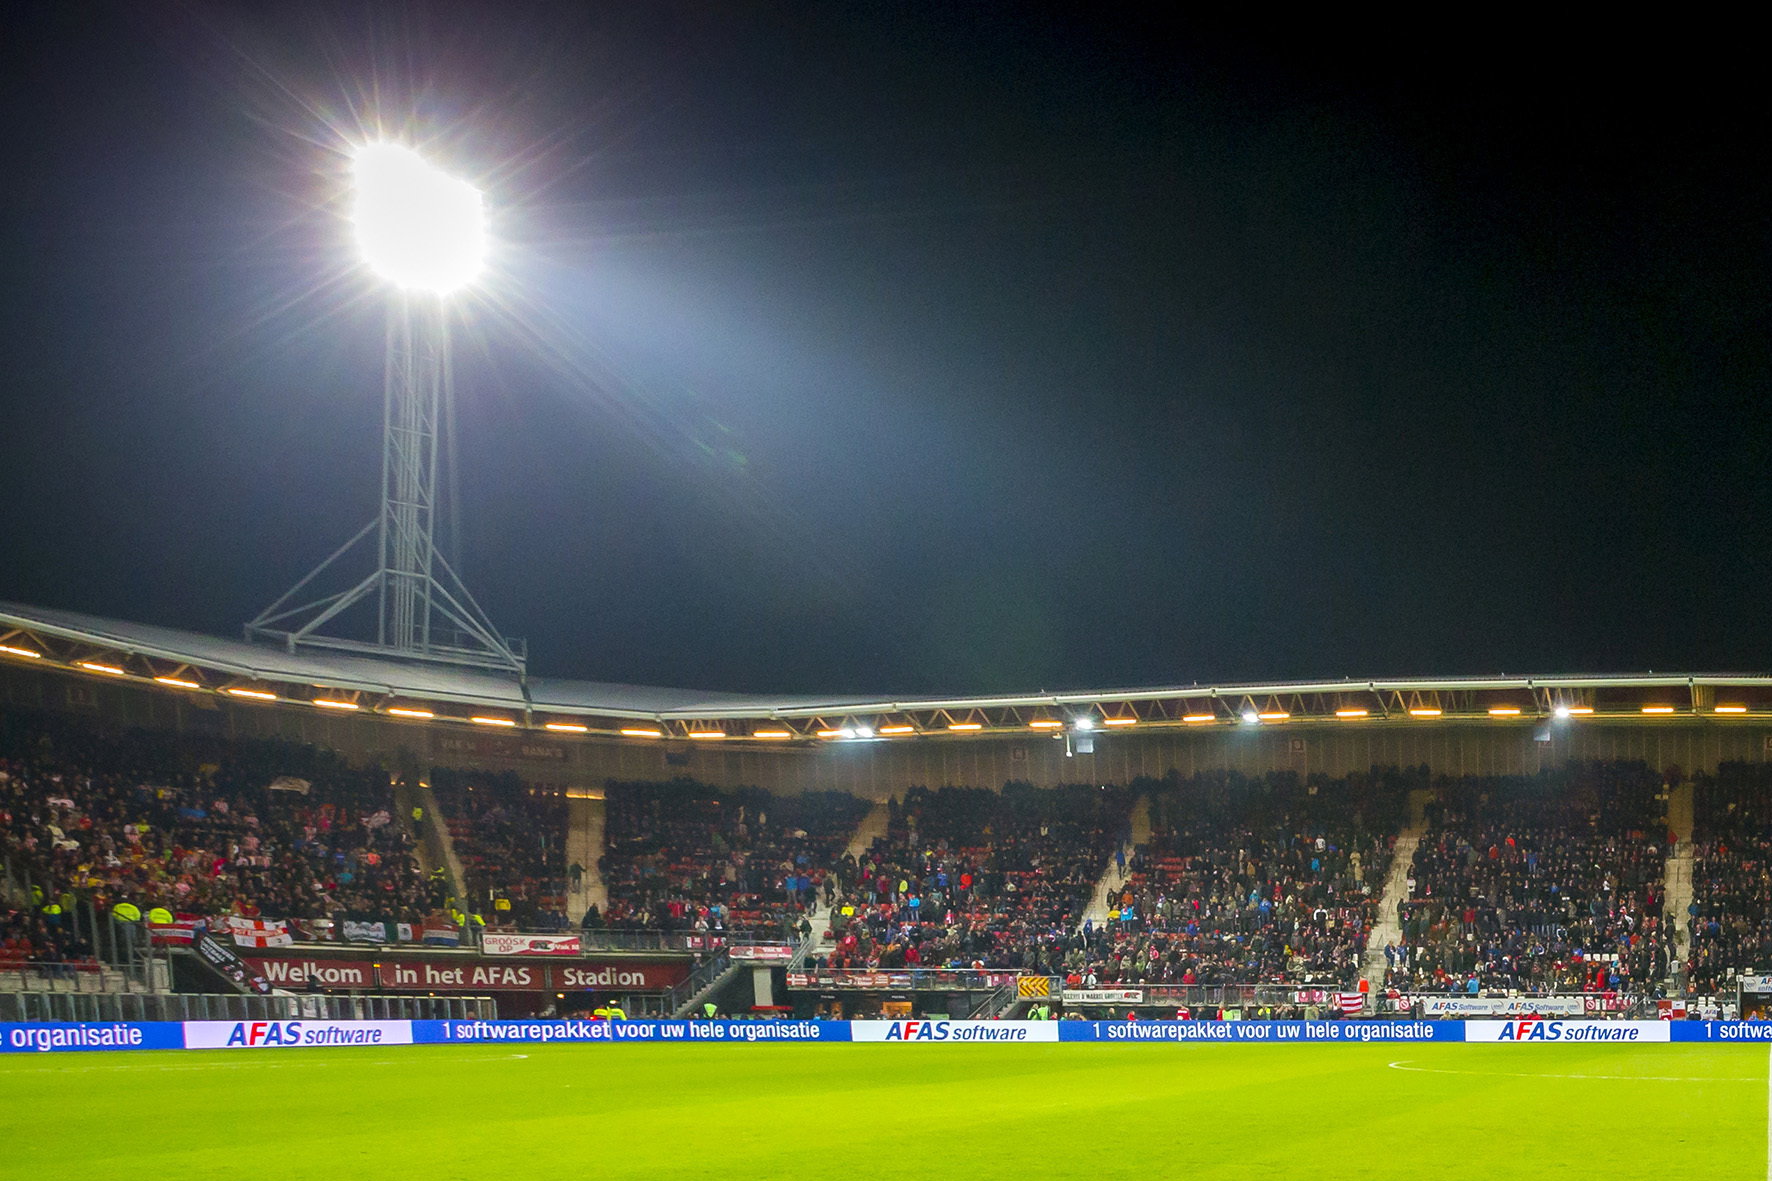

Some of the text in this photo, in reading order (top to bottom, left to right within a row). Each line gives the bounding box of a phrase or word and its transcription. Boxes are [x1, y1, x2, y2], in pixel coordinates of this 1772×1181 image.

[263, 961, 646, 986] Welkom in het AFAS Stadion
[1432, 1002, 1488, 1010] AFAS Software
[1508, 1002, 1564, 1010] AFAS Software
[10, 1024, 143, 1051] organisatie
[227, 1021, 382, 1046] AFAS software
[443, 1021, 820, 1042] 1 softwarepakket voor uw hele organisatie
[885, 1021, 1027, 1041] AFAS software
[1093, 1021, 1434, 1042] 1 softwarepakket voor uw hele organisatie
[1498, 1021, 1639, 1041] AFAS software
[1704, 1022, 1712, 1038] 1
